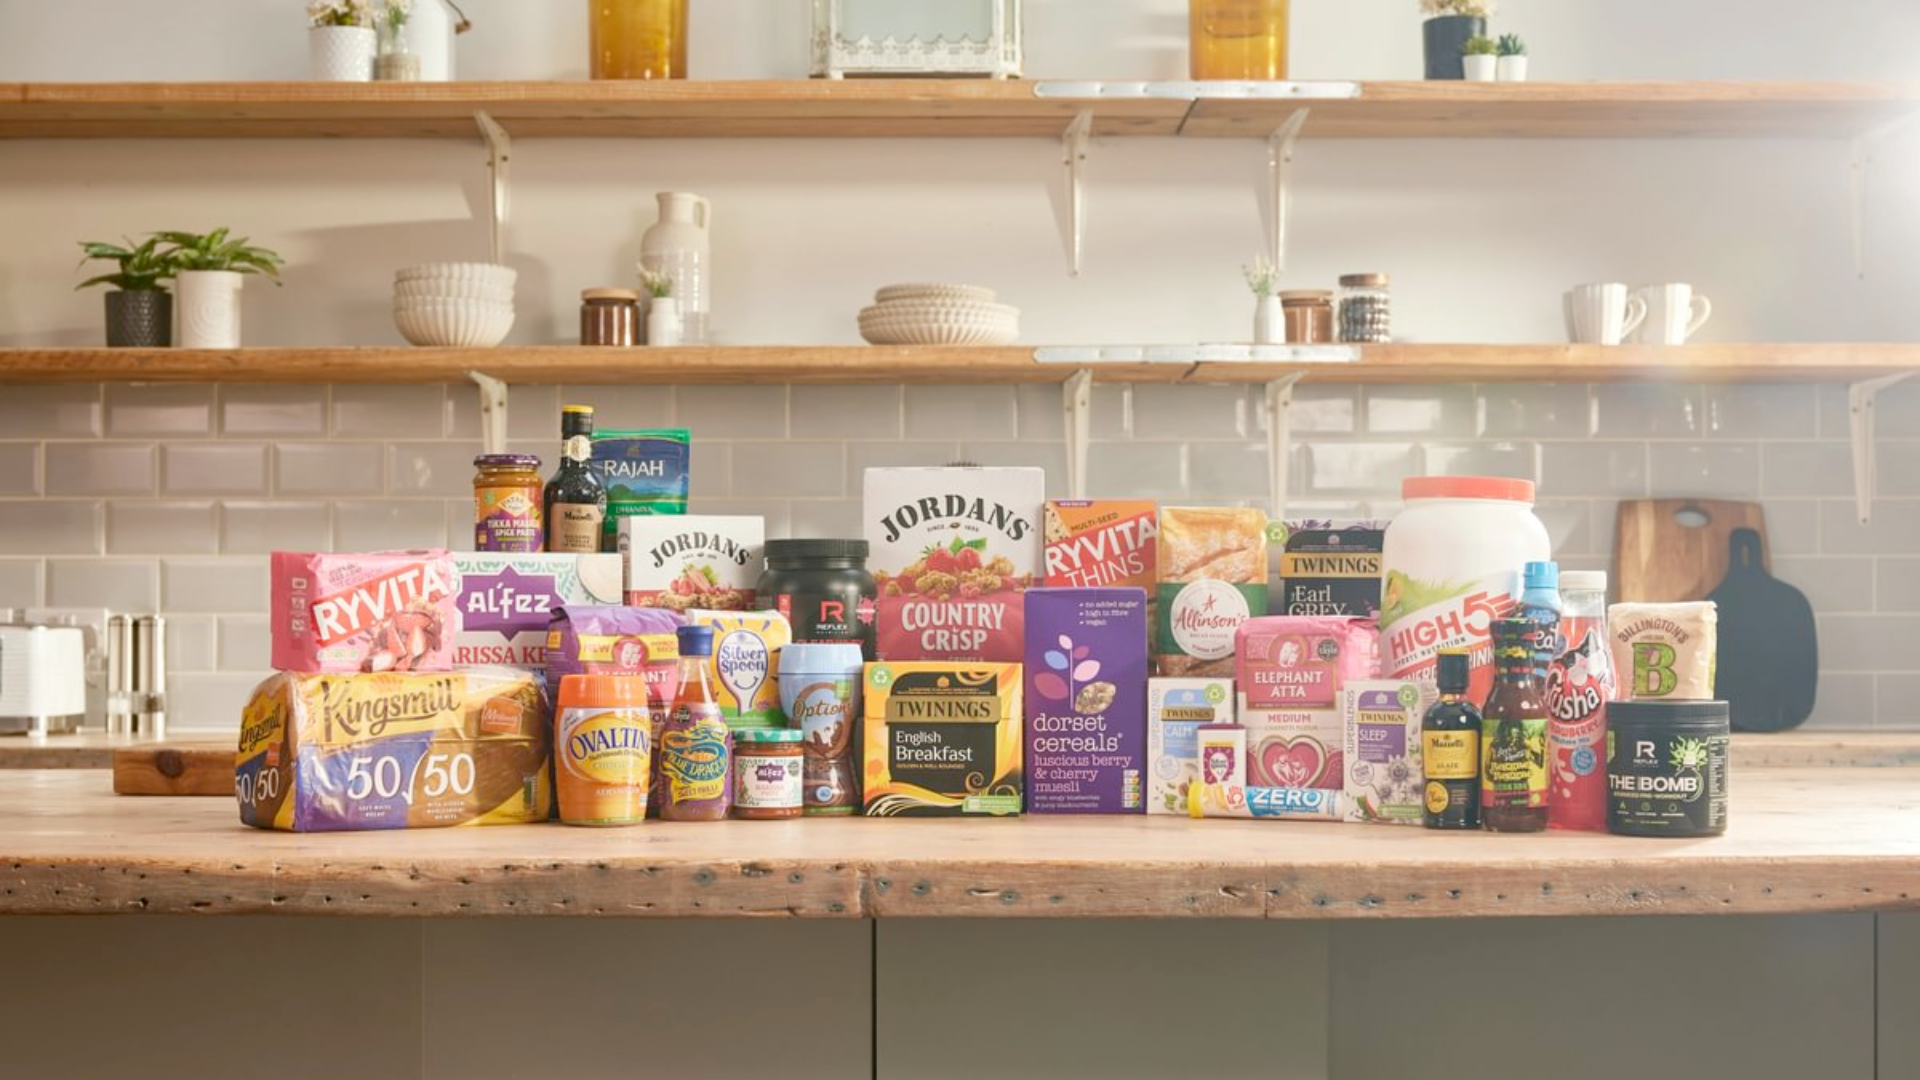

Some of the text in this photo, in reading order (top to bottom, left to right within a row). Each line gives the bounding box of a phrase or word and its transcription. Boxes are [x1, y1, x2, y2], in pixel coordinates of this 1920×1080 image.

[604, 460, 664, 478] RAJAH
[880, 494, 1030, 543] JORDANS
[1070, 512, 1119, 533] MULTI-SEED
[650, 532, 750, 568] JORDANS
[1045, 516, 1159, 578] RYVITA
[1064, 551, 1145, 587] THINS
[1290, 557, 1379, 574] TWININGS
[312, 560, 450, 640] RYVITA
[1295, 585, 1331, 602] Earl
[901, 602, 1006, 632] COUNTRY
[1288, 603, 1347, 616] GREY
[1174, 607, 1246, 631] Allinson's
[1618, 618, 1689, 644] BILLINGTON'S
[722, 646, 764, 661] Silver
[1254, 671, 1323, 684] ELEPHANT
[1631, 642, 1677, 696] B
[1270, 686, 1306, 698] ATTA
[321, 678, 461, 742] Kingsmill
[896, 701, 991, 718] TWININGS
[1165, 709, 1211, 718] TWININGS
[1360, 713, 1404, 722] TWININGS
[1033, 713, 1106, 732] dorset
[1267, 714, 1311, 723] MEDIUM
[896, 731, 942, 747] English
[1165, 728, 1193, 737] CALM
[1359, 729, 1388, 741] SLEEP
[1033, 733, 1118, 752] cereals
[896, 746, 973, 762] Breakfast
[1034, 754, 1132, 768] luscious berry
[1035, 767, 1098, 782] & cherry
[1608, 773, 1636, 790] THE
[1641, 776, 1697, 792] BOMB
[1035, 781, 1080, 792] muesli
[1252, 788, 1322, 807] ZERO
